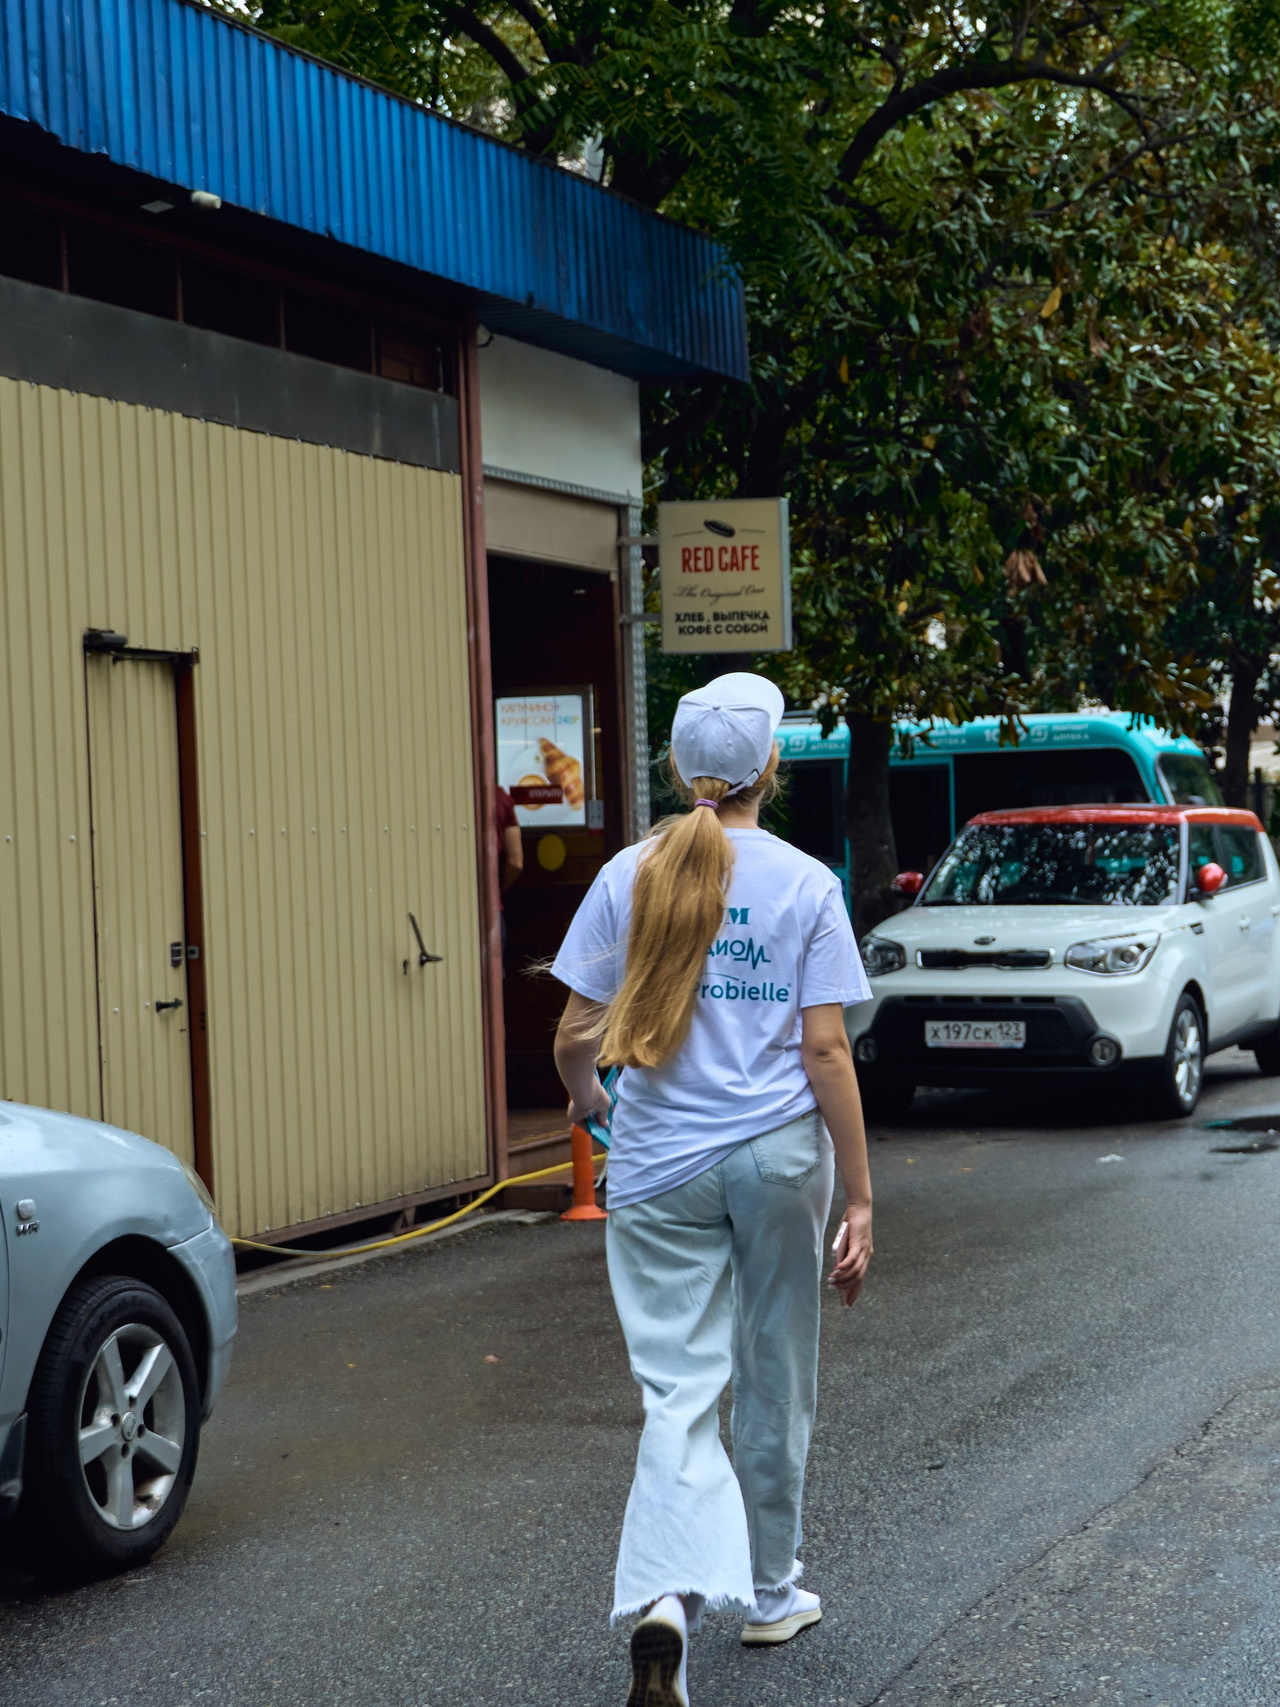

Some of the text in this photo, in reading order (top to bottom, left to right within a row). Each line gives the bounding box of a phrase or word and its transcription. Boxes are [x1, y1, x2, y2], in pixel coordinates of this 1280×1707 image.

[681, 545, 760, 573] RED CAFE
[673, 584, 766, 607] The Original One
[713, 610, 770, 622] ВЫПЕЧКА
[678, 620, 769, 635] КОФЕ С СОБОЙ
